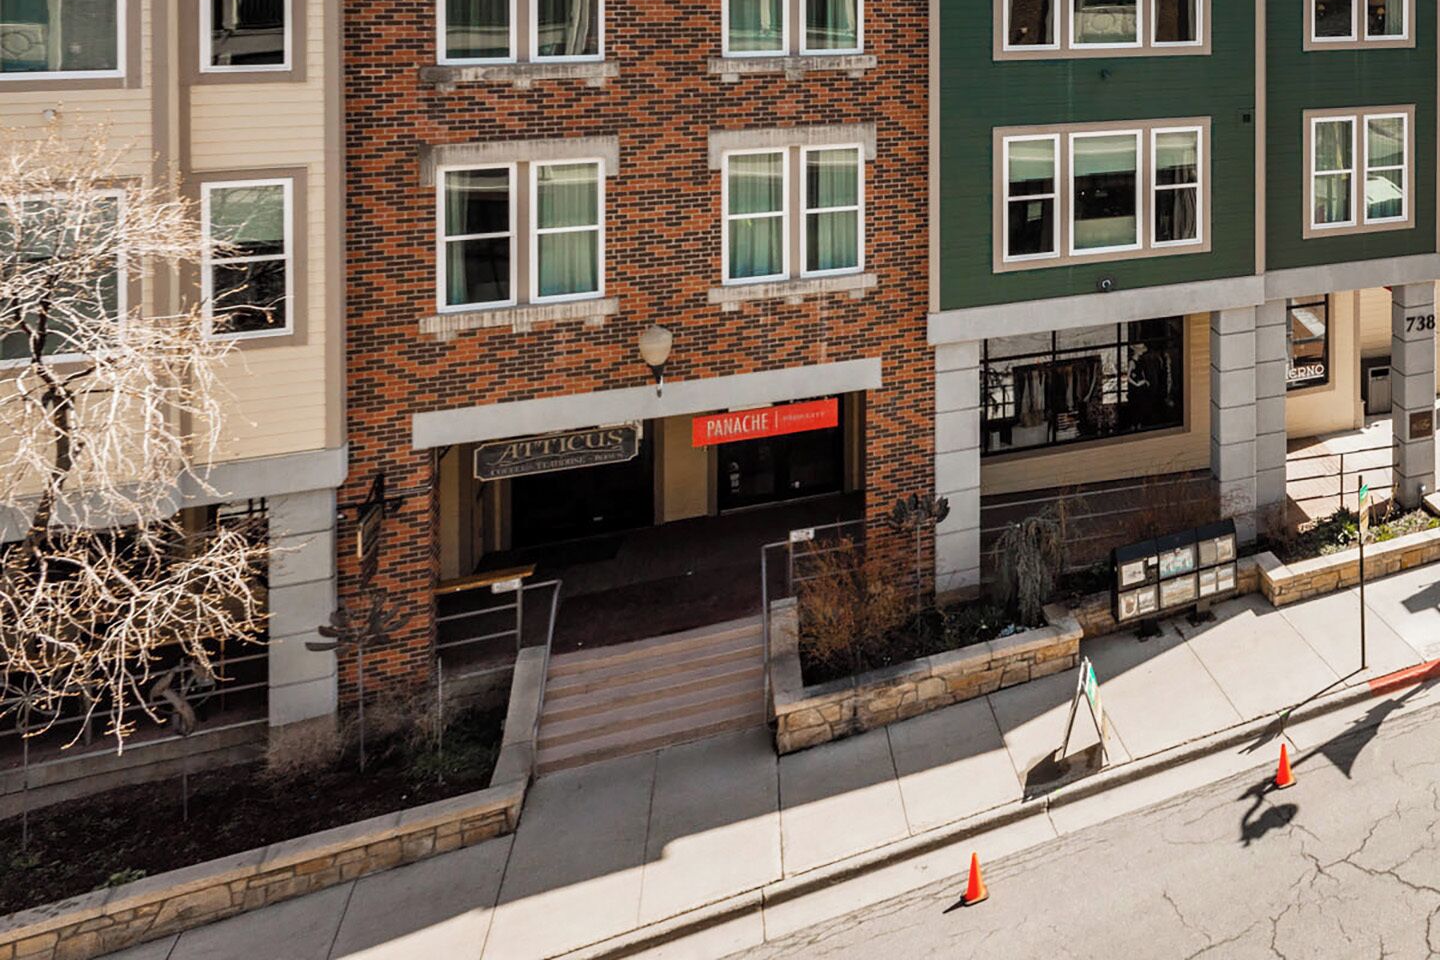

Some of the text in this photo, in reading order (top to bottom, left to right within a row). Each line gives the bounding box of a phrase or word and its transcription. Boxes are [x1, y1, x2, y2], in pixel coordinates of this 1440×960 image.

[1406, 315, 1435, 333] 738
[706, 412, 769, 438] PANACHE
[494, 429, 623, 466] ATTICUS
